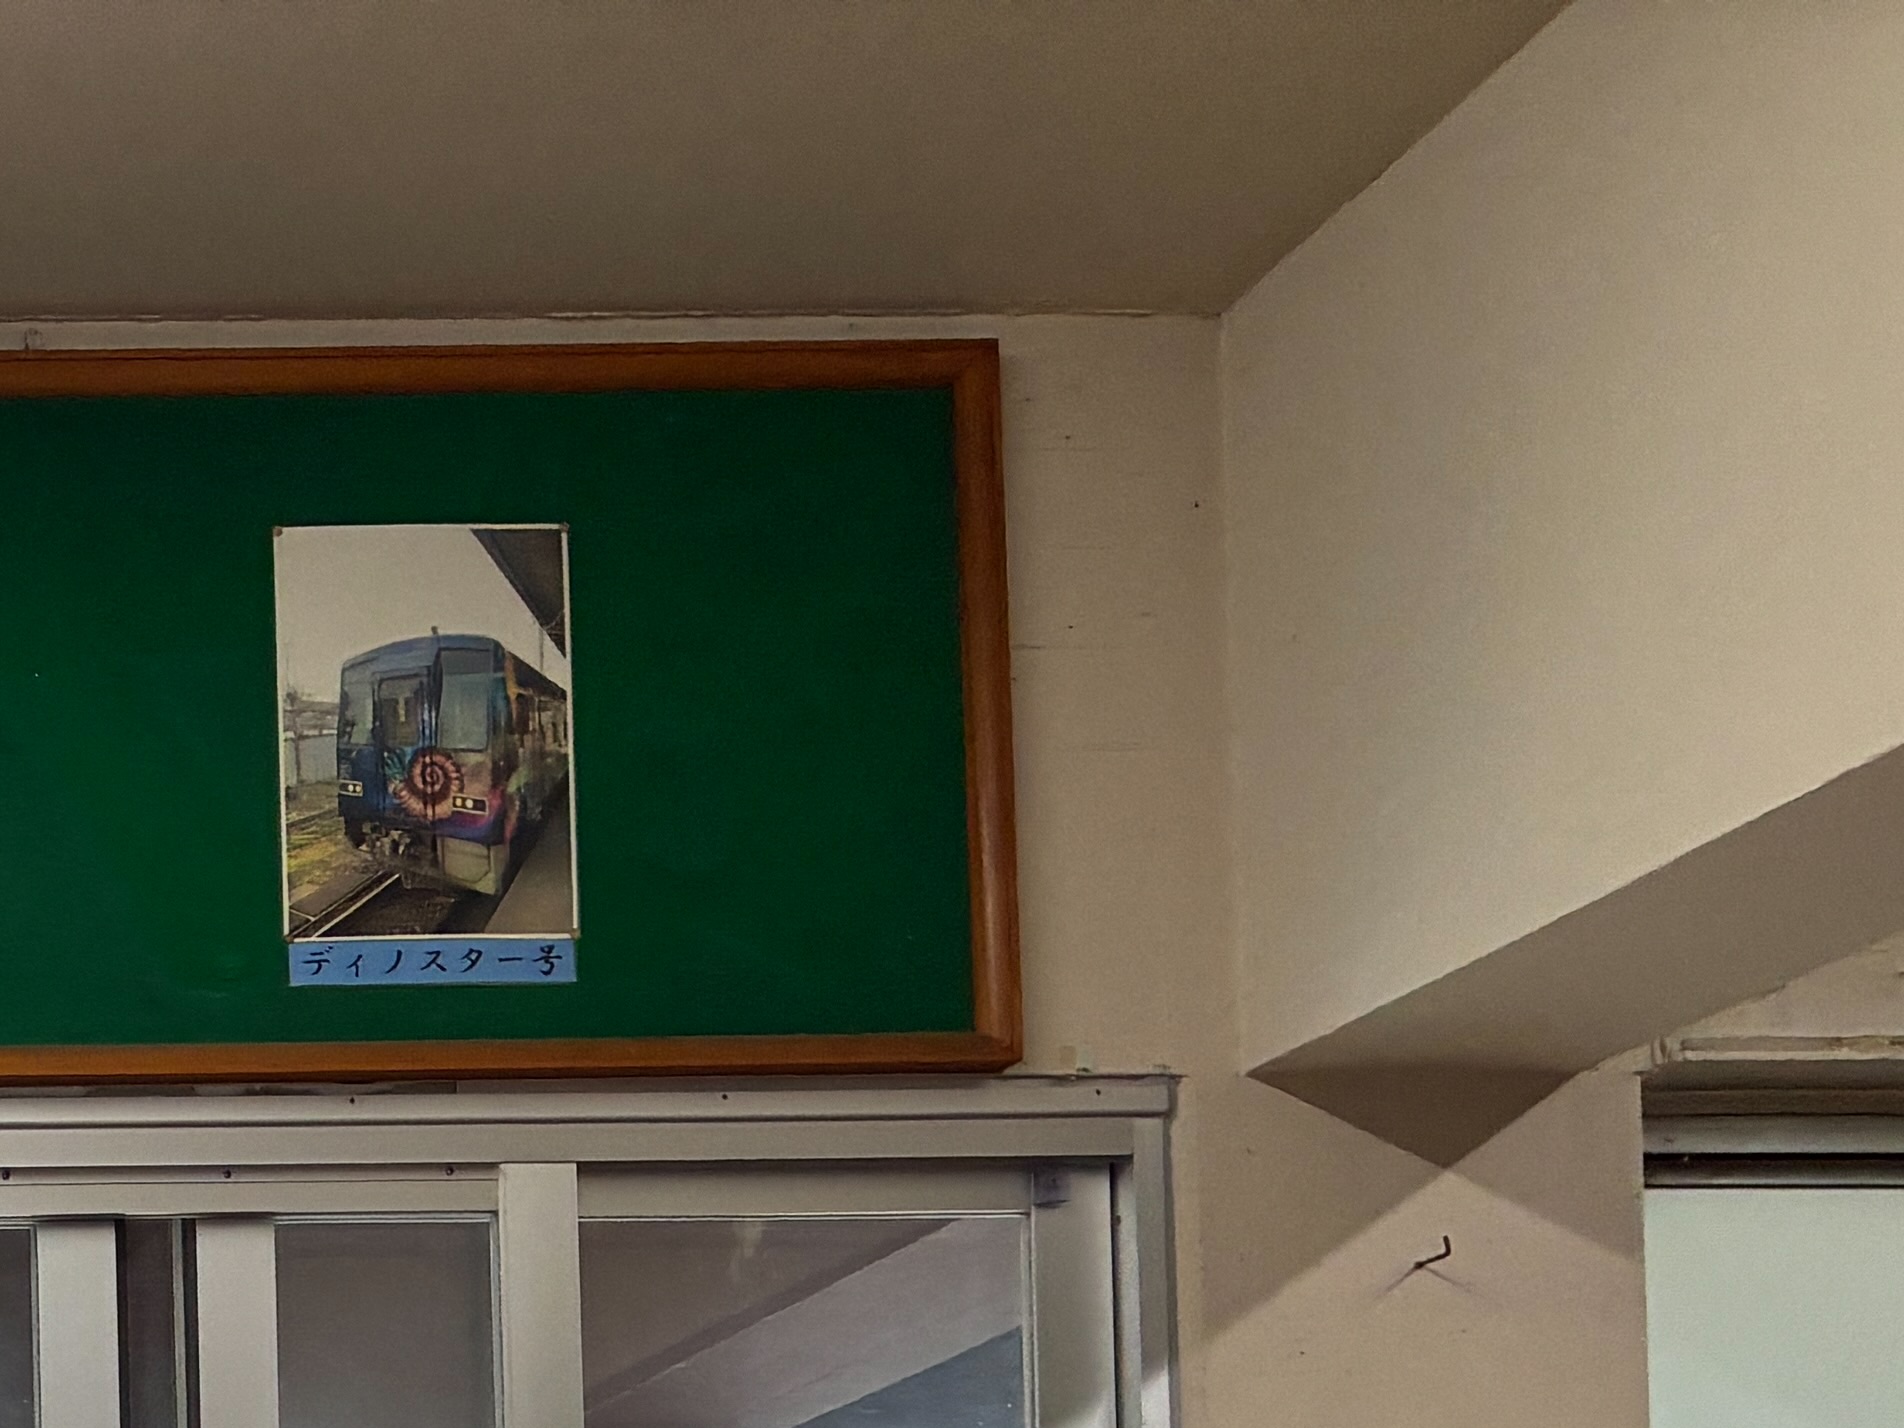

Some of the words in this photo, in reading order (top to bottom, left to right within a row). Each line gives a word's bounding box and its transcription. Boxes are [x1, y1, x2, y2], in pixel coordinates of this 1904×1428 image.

[304, 942, 563, 978] ディノスター号
